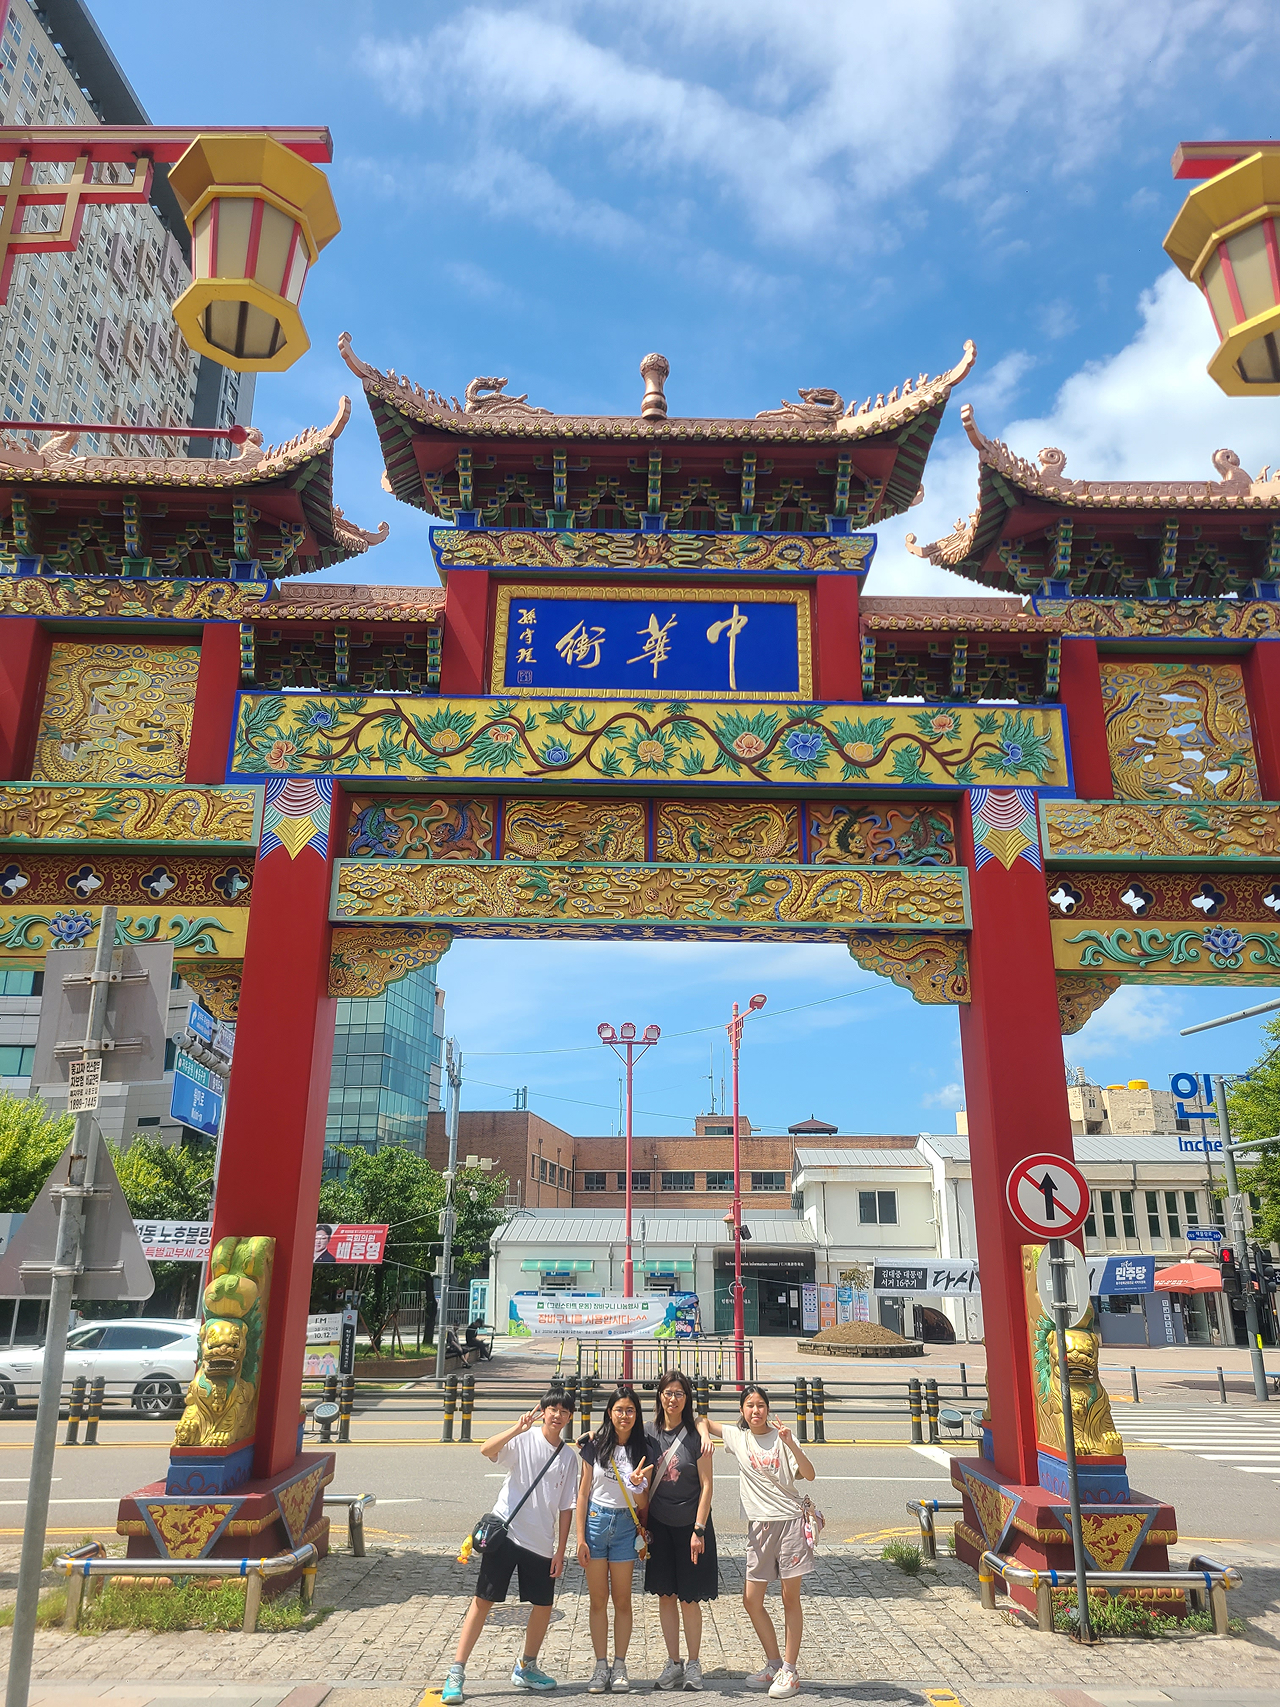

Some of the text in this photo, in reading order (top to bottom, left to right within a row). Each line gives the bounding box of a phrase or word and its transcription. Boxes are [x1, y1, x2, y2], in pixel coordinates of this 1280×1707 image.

[1178, 1136, 1223, 1152] Inche
[145, 1247, 195, 1258] 특별교부세
[336, 1242, 381, 1260] 배준영
[881, 1269, 923, 1279] 김대중 대통령
[1115, 1266, 1147, 1280] 민주당
[881, 1279, 917, 1288] 서거 16주기
[538, 1314, 583, 1325] 장바구니를
